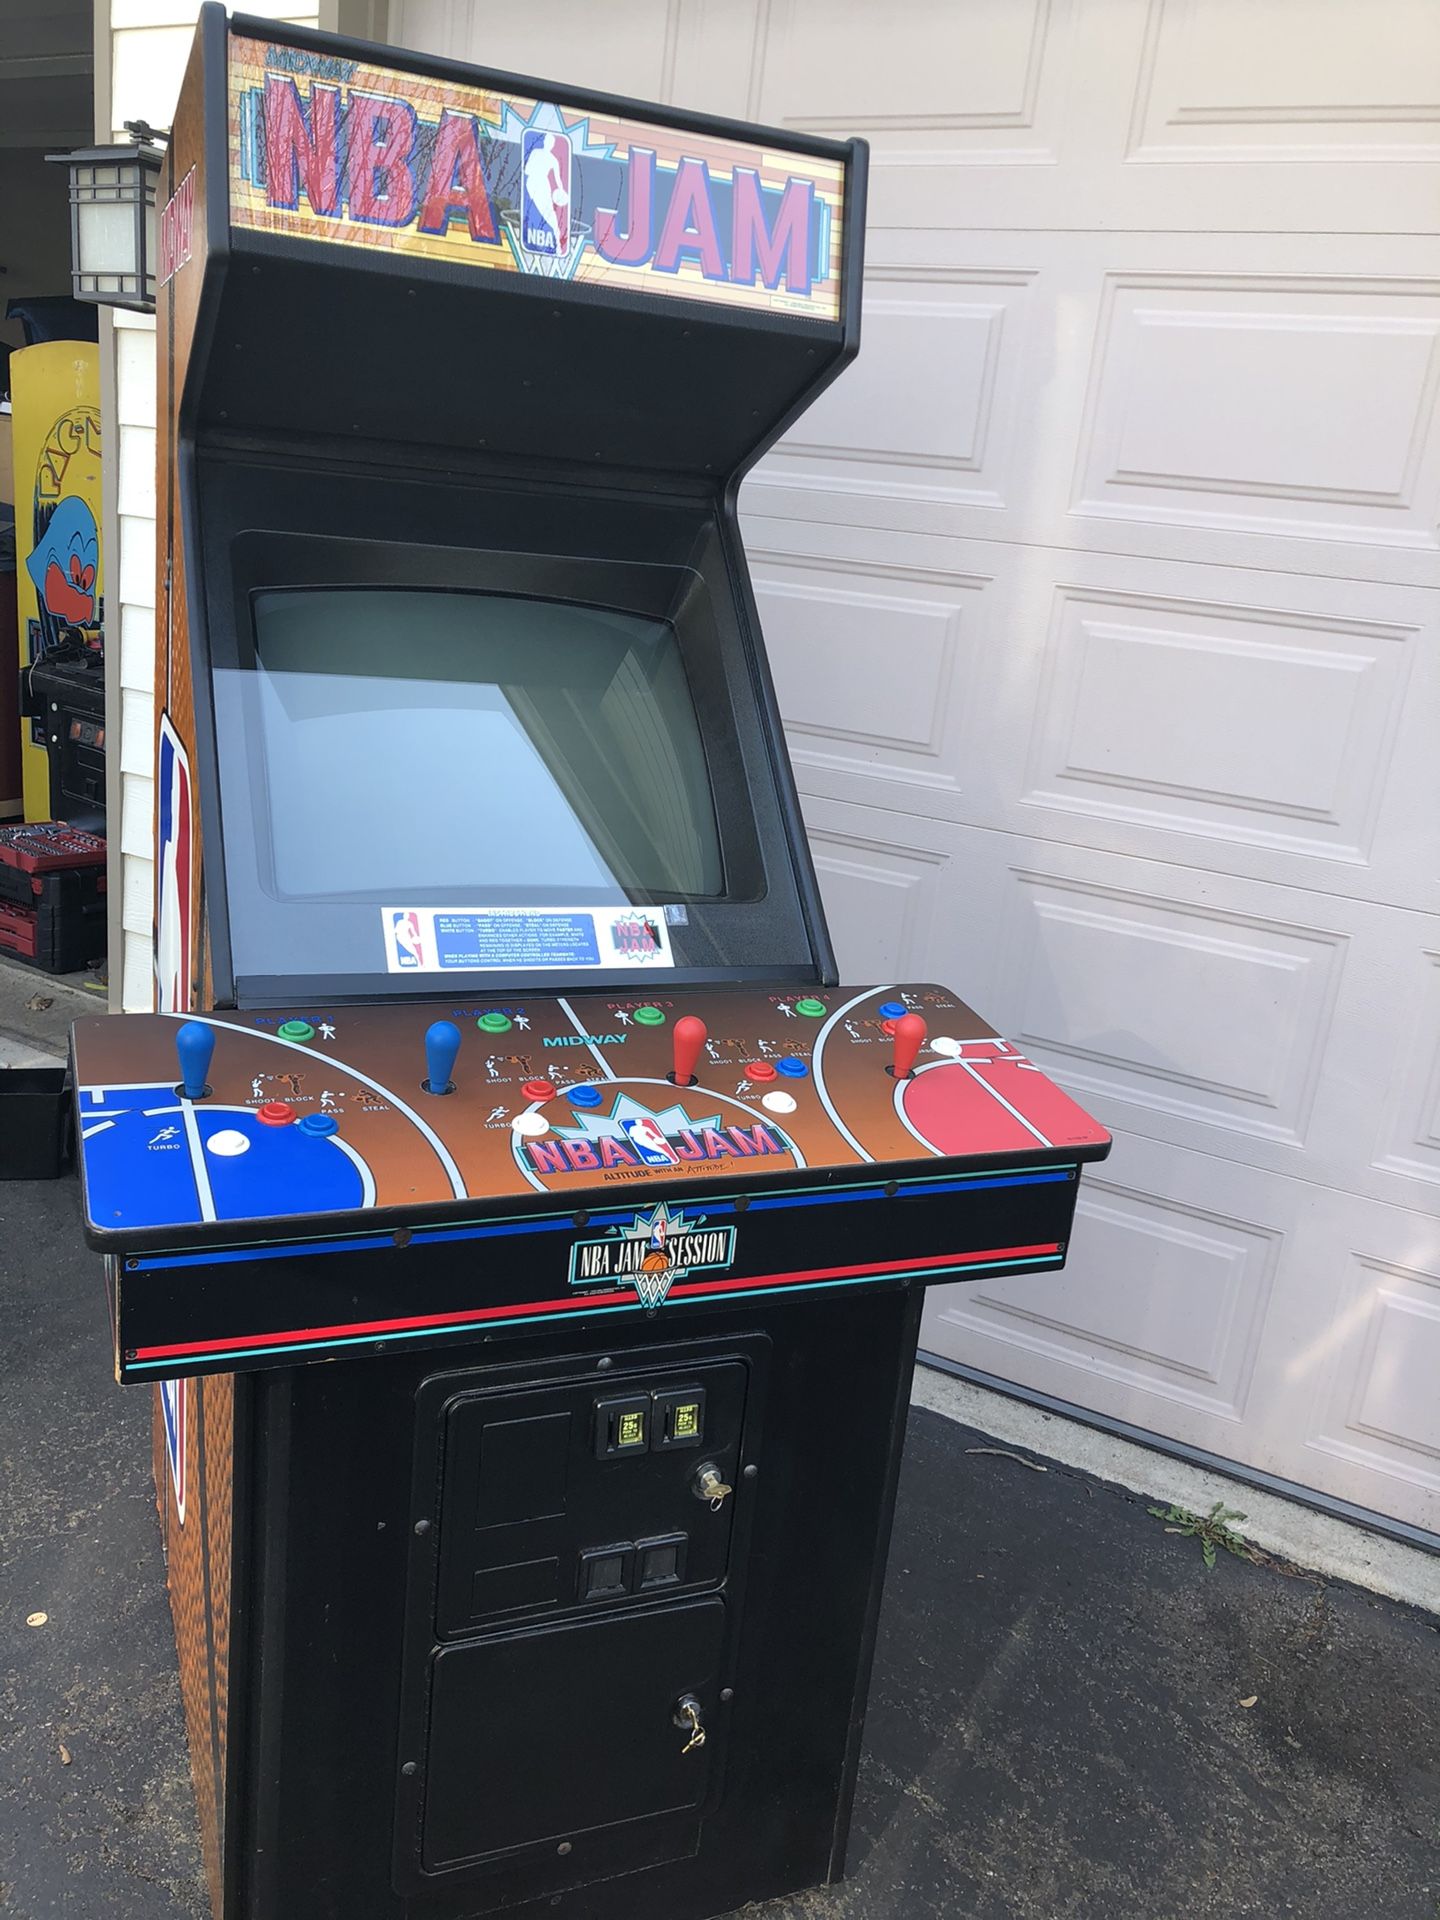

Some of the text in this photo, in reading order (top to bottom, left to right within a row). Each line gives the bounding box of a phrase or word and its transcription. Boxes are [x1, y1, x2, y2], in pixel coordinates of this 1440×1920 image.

[263, 71, 501, 246] NBA
[595, 144, 816, 296] JAM
[526, 227, 556, 249] NBA
[614, 921, 655, 937] NBA
[619, 937, 656, 953] JAM
[516, 1007, 526, 1015] 2
[607, 1000, 674, 1010] PLAYER 3
[328, 1014, 334, 1024] 1
[542, 1033, 628, 1048] MIDWAY
[284, 1095, 315, 1103] BLOCK
[736, 1093, 762, 1101] TURBO
[147, 1143, 181, 1152] TURBO
[525, 1124, 788, 1175] NBA JAM
[647, 1154, 669, 1164] NBA
[603, 1169, 652, 1181] ALTITUDE
[580, 1232, 728, 1278] NBA JAM SESSION
